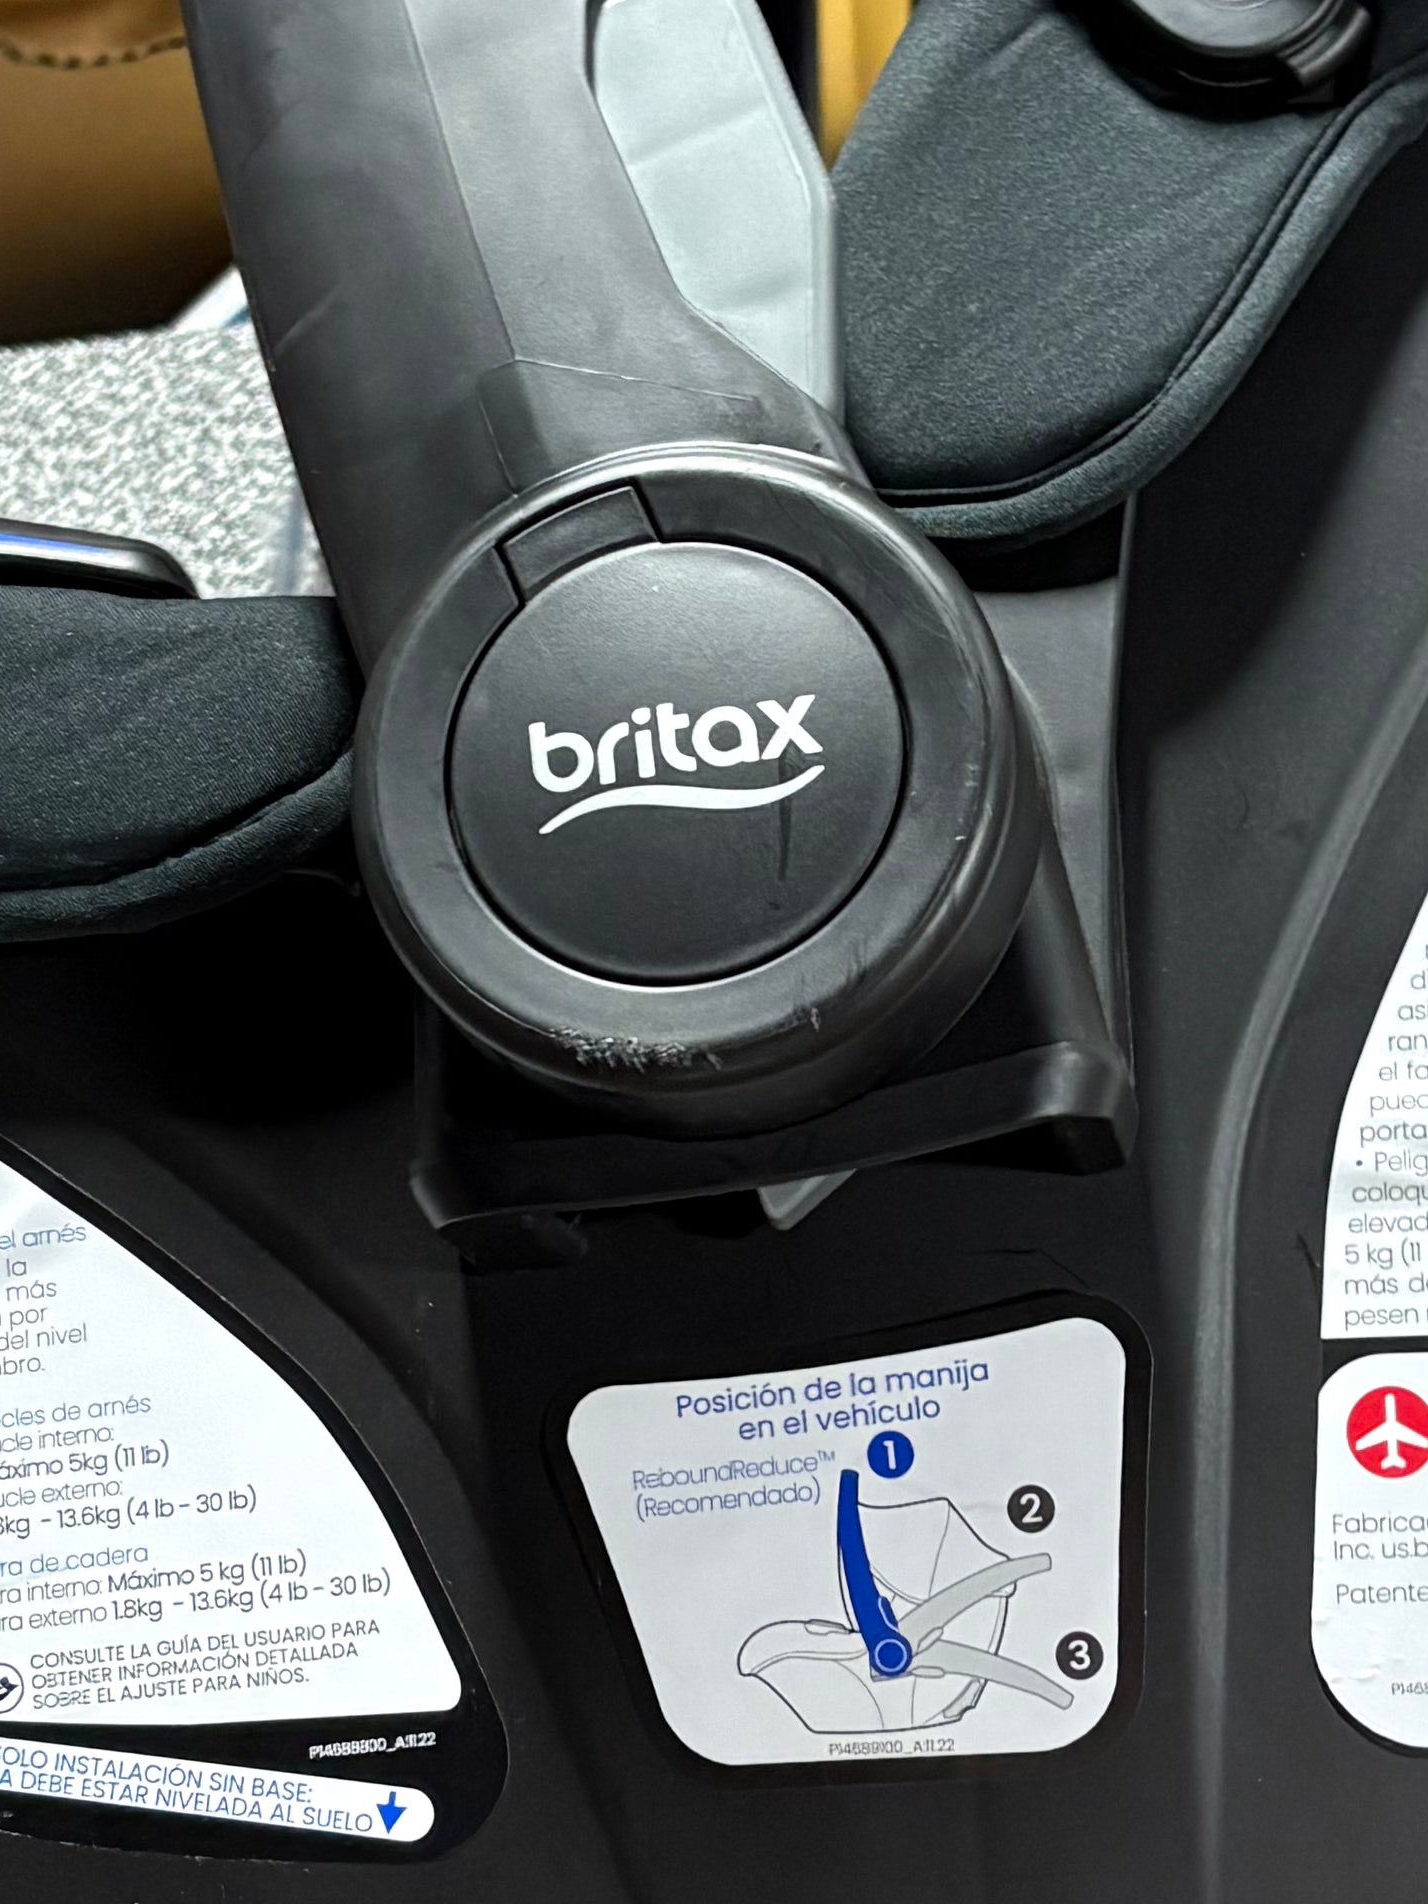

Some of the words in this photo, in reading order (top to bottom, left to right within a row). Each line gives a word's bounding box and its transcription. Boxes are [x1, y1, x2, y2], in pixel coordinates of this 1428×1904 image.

[527, 693, 825, 793] britax
[1344, 1307, 1420, 1332] pesen
[51, 1401, 82, 1423] de
[87, 1393, 152, 1419] arnés
[675, 1382, 797, 1419] Posición
[802, 1376, 843, 1403] de
[848, 1372, 878, 1398] la
[884, 1358, 990, 1394] manija
[737, 1418, 776, 1441] en
[782, 1408, 809, 1436] el
[814, 1394, 941, 1432] vehículo
[68, 1451, 109, 1477] 5kg
[882, 1440, 898, 1471] 1
[635, 1474, 821, 1524] (Recomendado)
[1020, 1495, 1045, 1524] 2
[1333, 1539, 1376, 1562] Inc.
[29, 1644, 126, 1671] CONSULTE
[130, 1642, 152, 1660] LA
[156, 1633, 203, 1657] GUÍA
[206, 1633, 241, 1658] DEL
[243, 1623, 327, 1648] USUARIO
[330, 1618, 381, 1640] PARA
[1069, 1640, 1093, 1671] 3
[53, 1753, 203, 1789] INSTALACIÓN
[208, 1772, 245, 1795] SIN
[251, 1777, 313, 1804] BASE:
[21, 1769, 76, 1792] DEBE
[80, 1778, 149, 1805] ESTAR
[155, 1785, 263, 1820] NIVELADA
[270, 1802, 292, 1823] AL
[302, 1805, 374, 1831] SUELO
